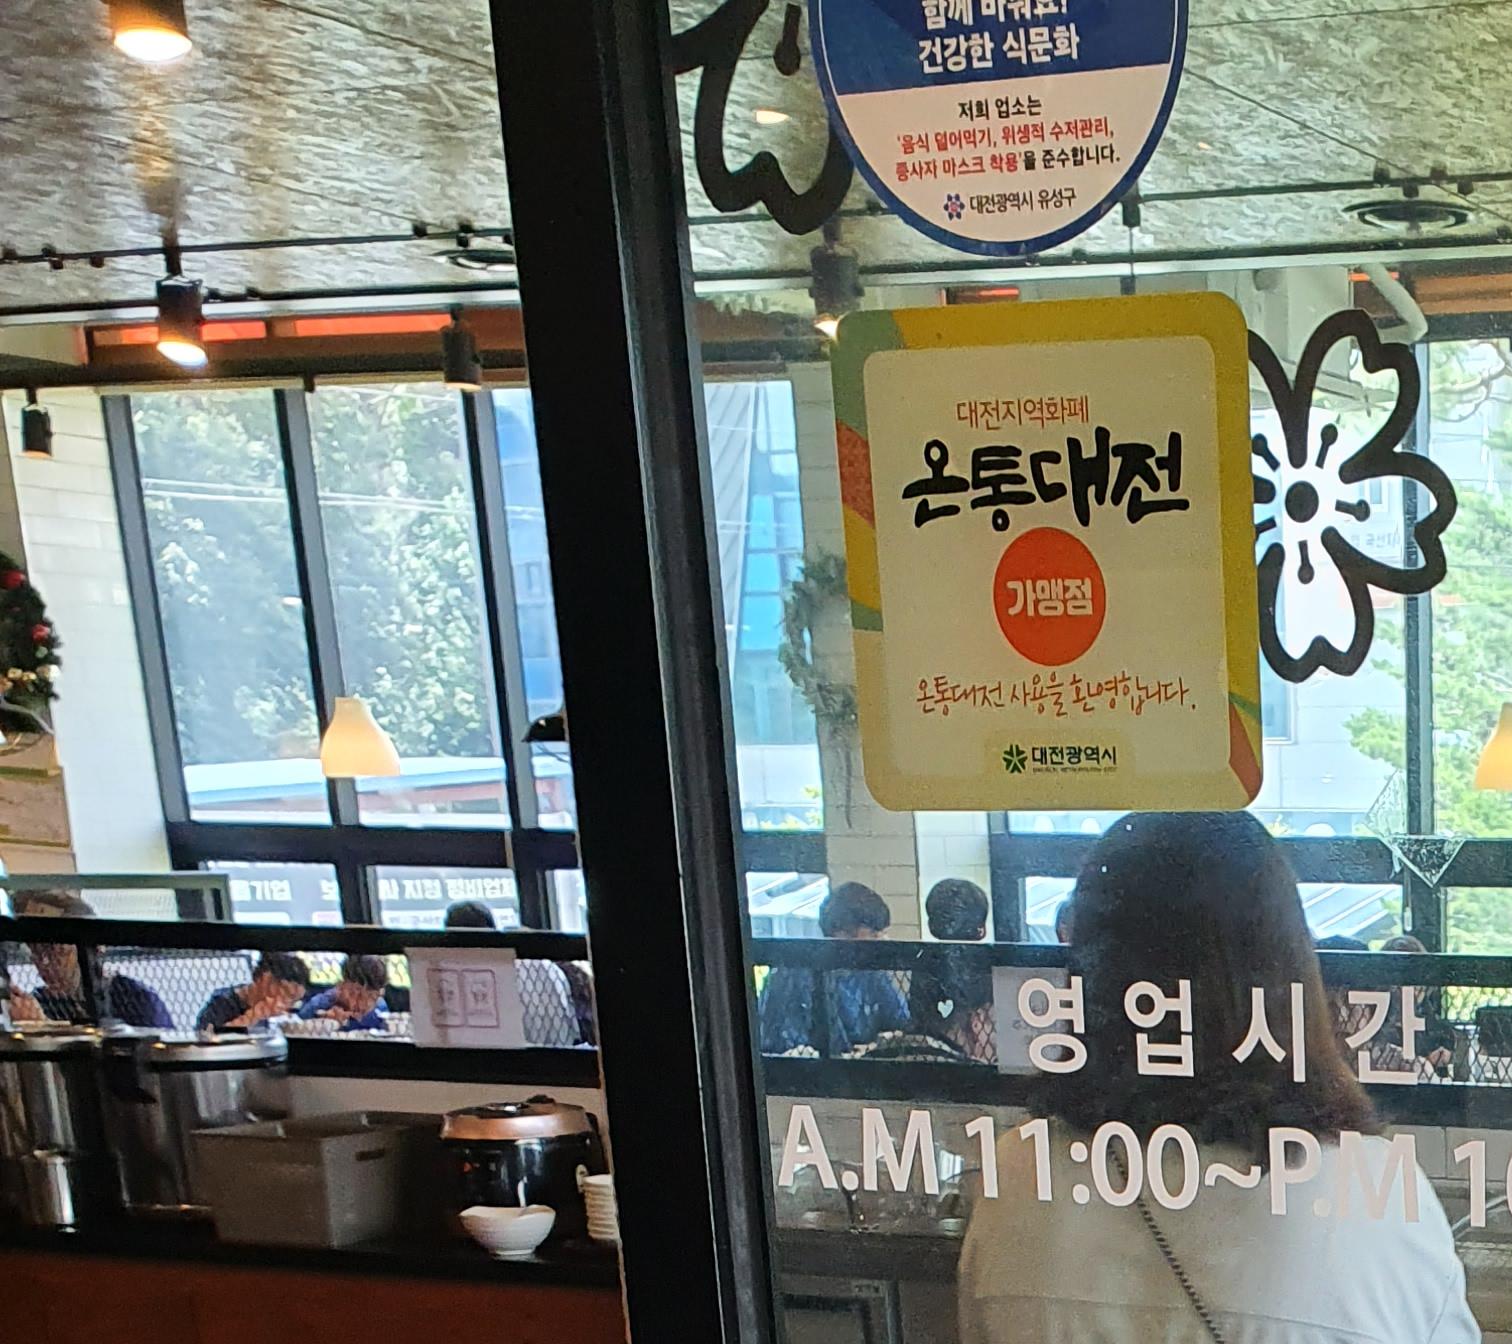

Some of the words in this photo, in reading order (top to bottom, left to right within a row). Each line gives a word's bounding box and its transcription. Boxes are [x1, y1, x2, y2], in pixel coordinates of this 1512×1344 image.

[919, 32, 994, 74] 건강한
[1002, 23, 1080, 64] 식문화
[958, 98, 989, 121] 저희
[995, 95, 1042, 118] 업소는
[1001, 122, 1045, 146] 위생적
[1049, 116, 1114, 142] 수저관리,
[943, 155, 986, 177] 마스크
[1042, 143, 1121, 169] 준수합니다.
[970, 191, 1033, 214] 대전광역시
[1037, 188, 1077, 210] 유성구
[956, 395, 1090, 431] 대전지역화폐
[902, 426, 1190, 532] 온통대전
[1006, 577, 1093, 617] 가맹점
[916, 675, 1005, 716] 온통대전
[1010, 671, 1068, 717] 사용을
[1069, 670, 1197, 716] 환영합니다.
[1031, 745, 1117, 766] 대전광역시
[777, 1105, 940, 1198] A.M
